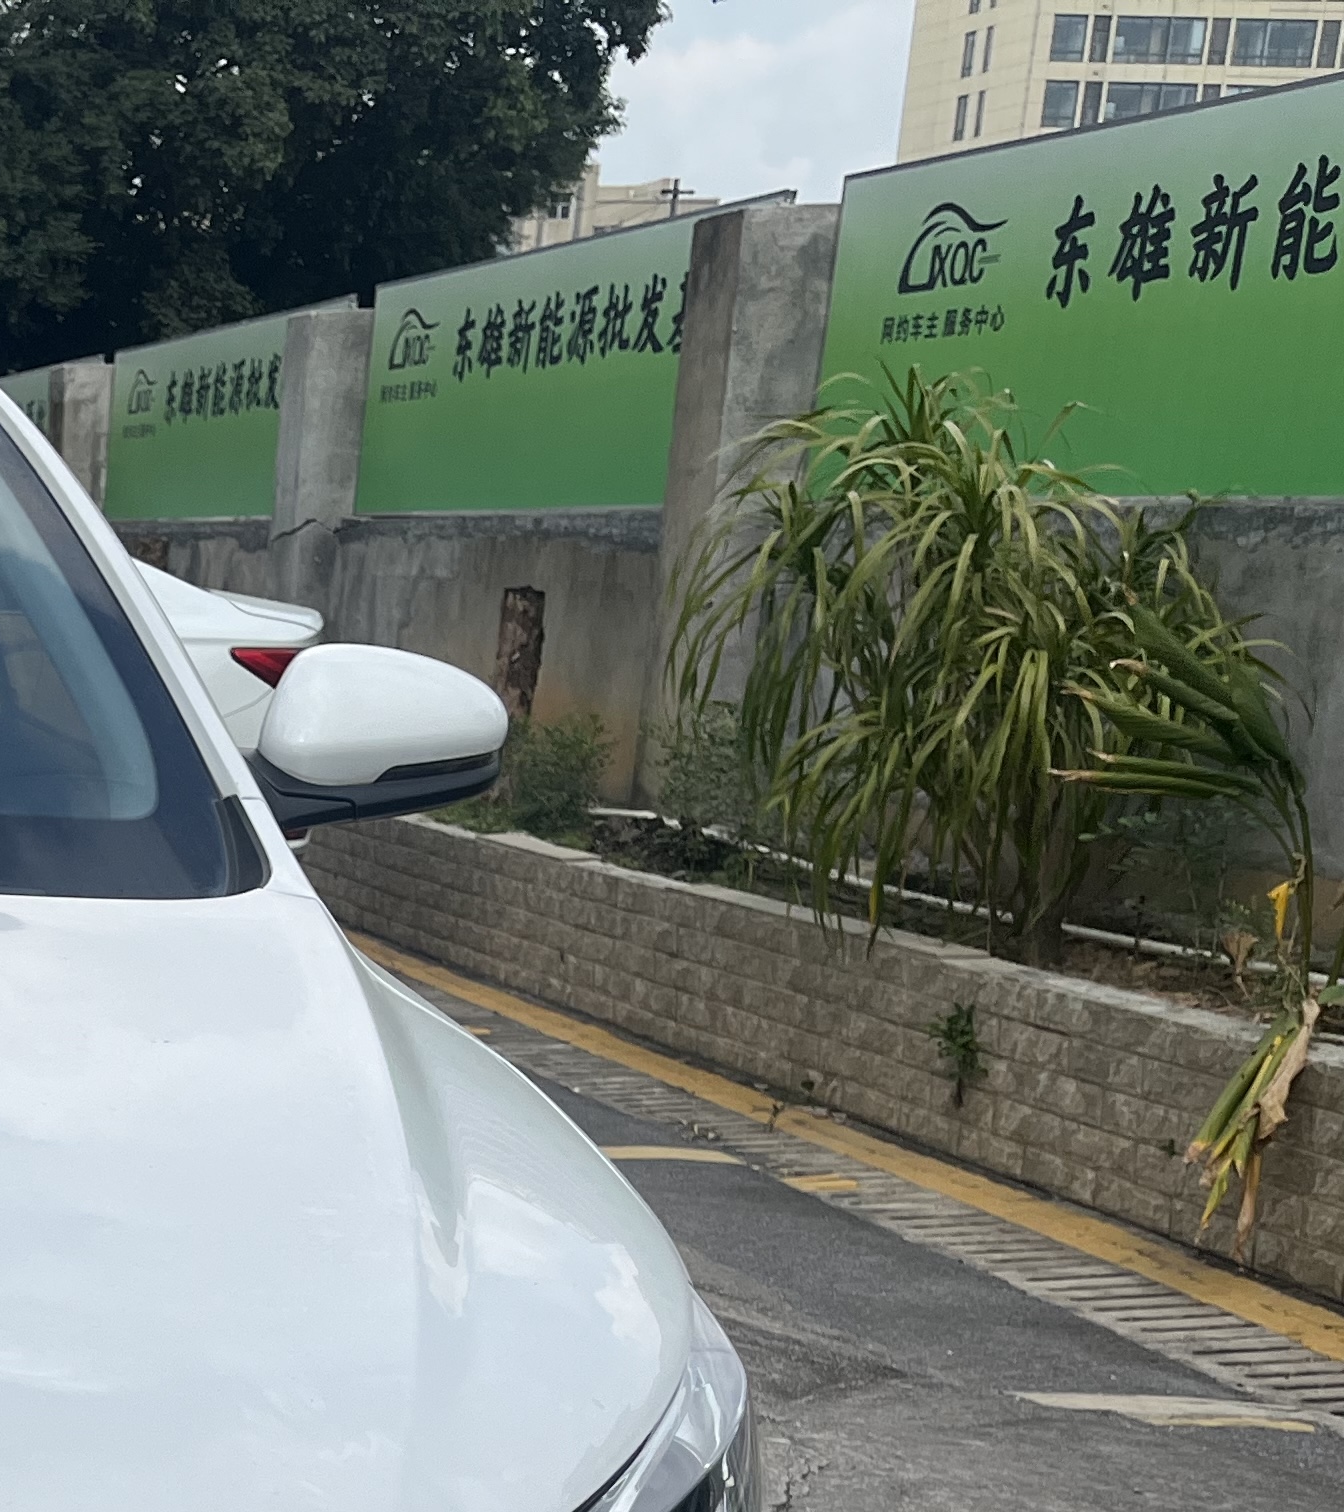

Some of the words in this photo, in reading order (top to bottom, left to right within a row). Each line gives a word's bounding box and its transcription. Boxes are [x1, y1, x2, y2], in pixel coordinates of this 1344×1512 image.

[1046, 154, 1341, 309] 东雄新能
[942, 304, 1005, 337] 服务中心
